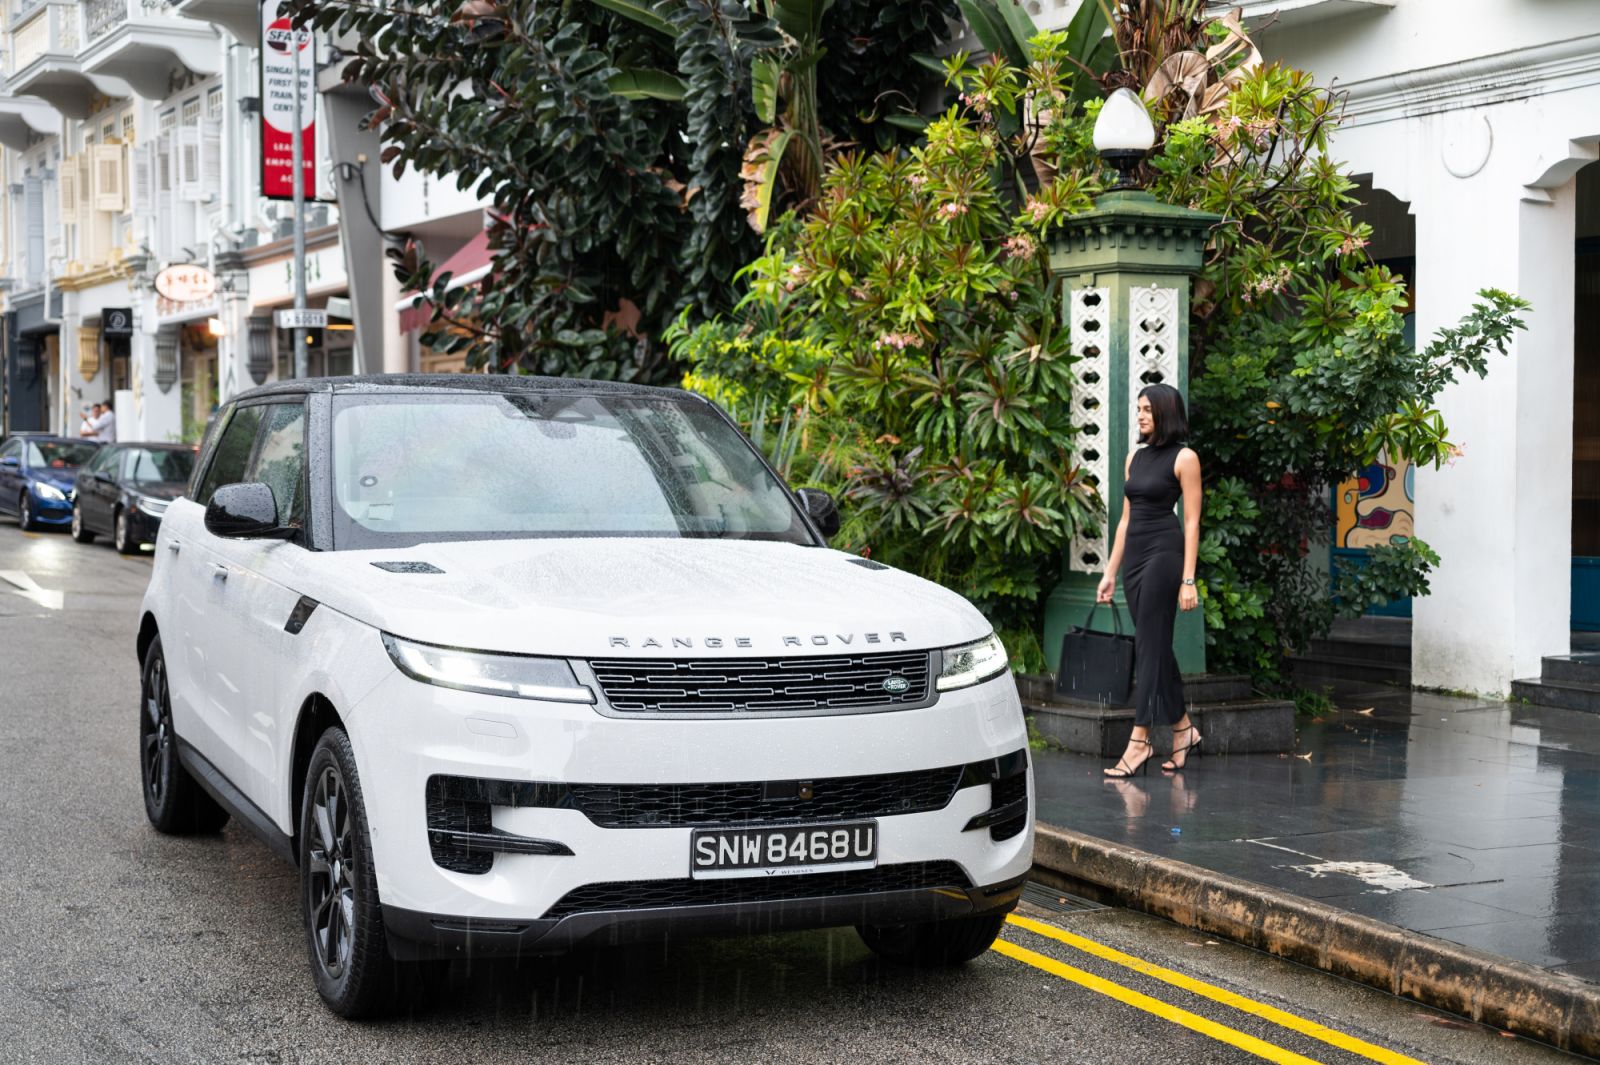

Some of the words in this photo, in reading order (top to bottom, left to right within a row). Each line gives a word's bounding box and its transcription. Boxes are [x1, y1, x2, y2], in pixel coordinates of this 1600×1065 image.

[269, 30, 307, 42] SFAC
[266, 65, 310, 77] SINGARE
[273, 103, 303, 113] CENTE
[265, 158, 313, 169] EMPOER
[608, 636, 752, 648] RANGE
[782, 631, 908, 647] ROVER
[696, 828, 873, 866] SNW8468U
